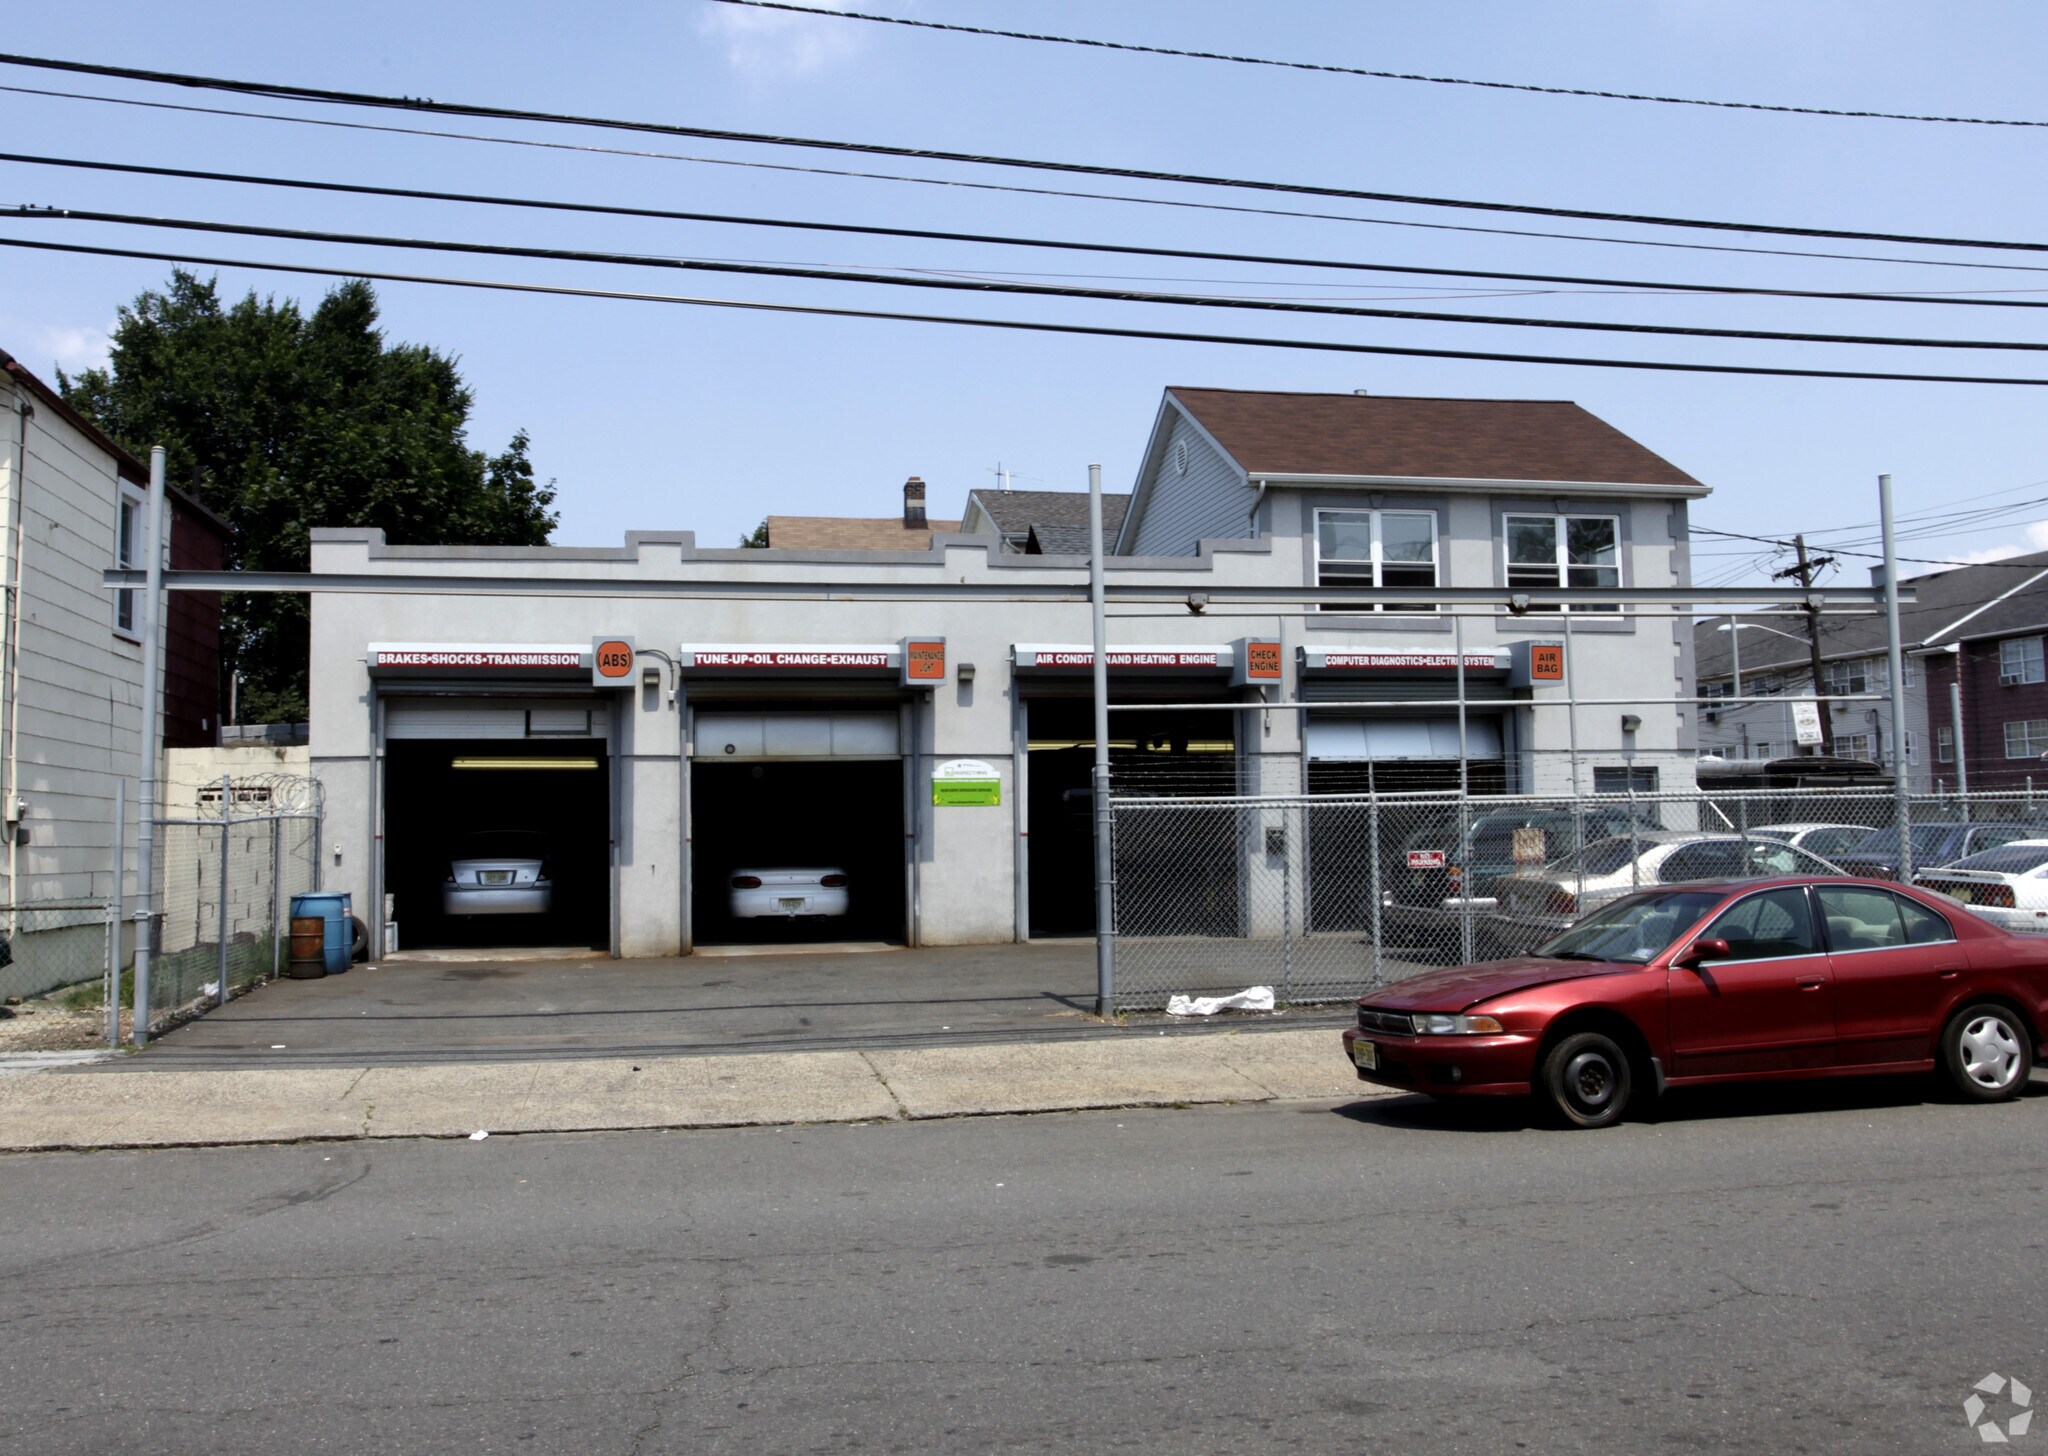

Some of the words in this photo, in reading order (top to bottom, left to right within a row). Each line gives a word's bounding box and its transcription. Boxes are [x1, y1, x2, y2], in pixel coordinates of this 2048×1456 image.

[488, 654, 579, 665] TRANSMISSION
[1036, 653, 1054, 664] AIR
[1133, 654, 1176, 665] HEATING
[1180, 654, 1216, 664] ENGINE
[1251, 650, 1278, 660] CHECK
[1538, 653, 1556, 662] AIR
[1325, 655, 1370, 666] COMPUTER
[1464, 656, 1495, 666] SYSTEM
[1250, 661, 1279, 671] ENGINE
[1536, 664, 1558, 673] BAG
